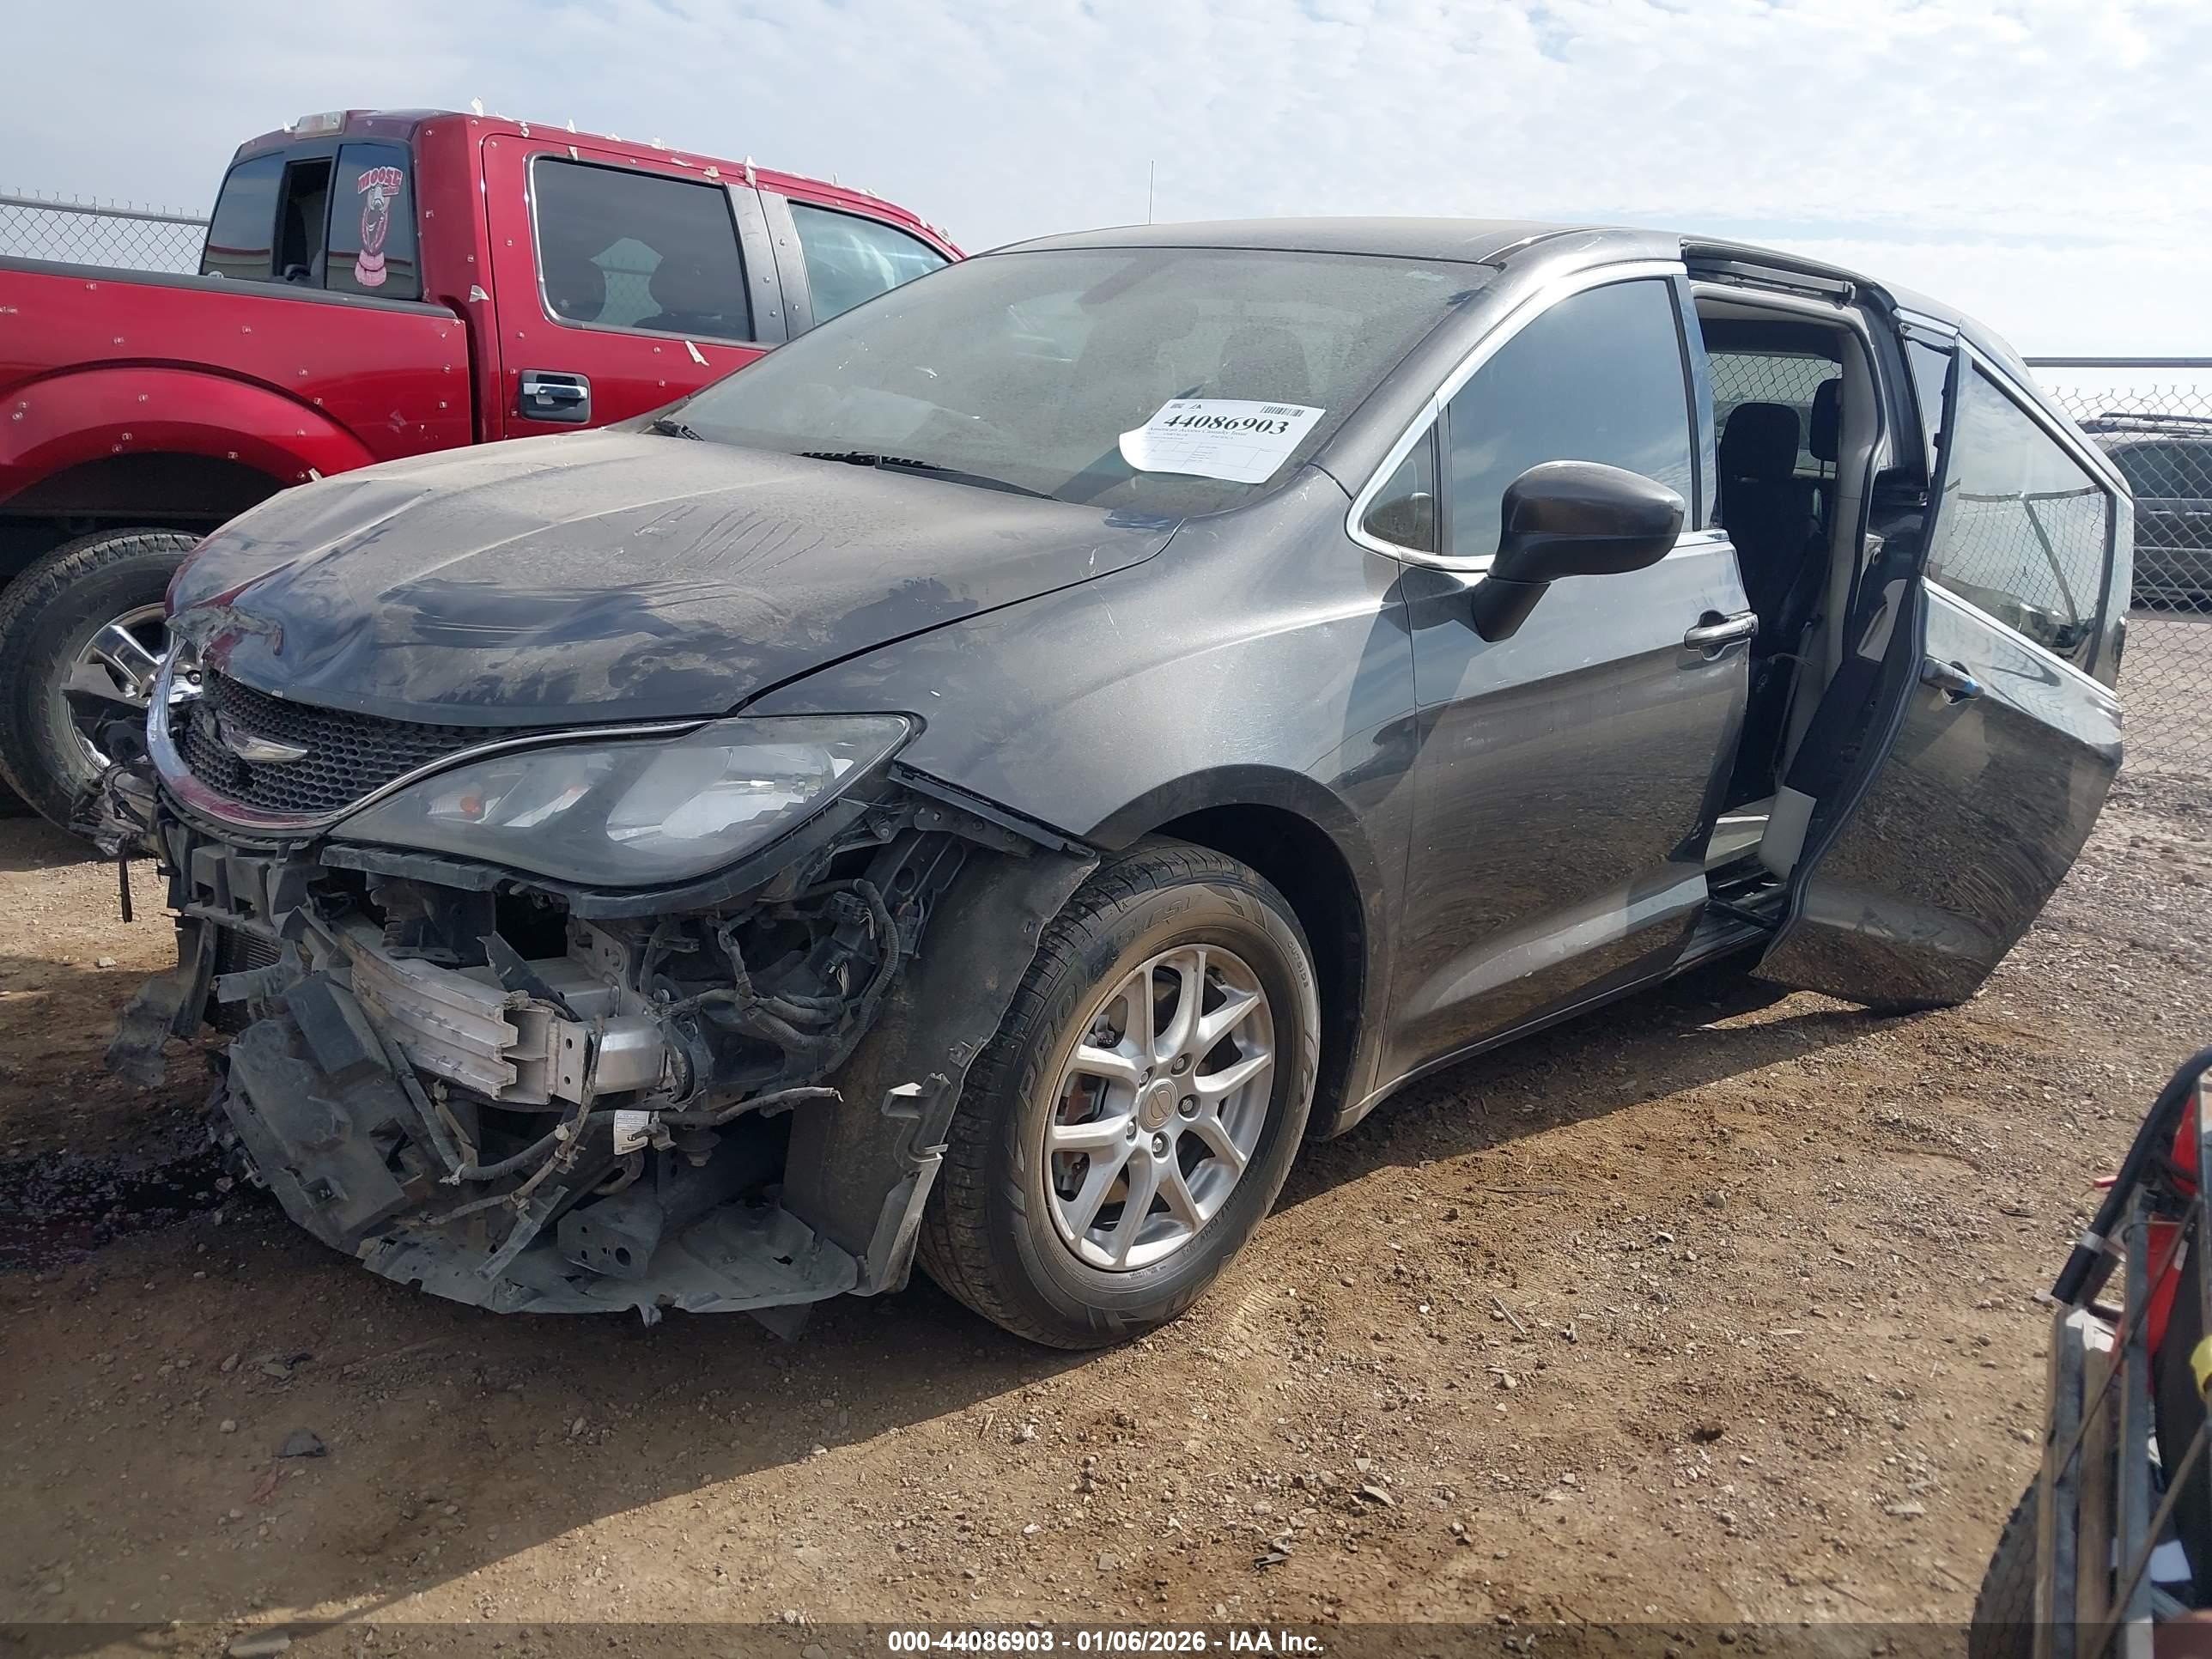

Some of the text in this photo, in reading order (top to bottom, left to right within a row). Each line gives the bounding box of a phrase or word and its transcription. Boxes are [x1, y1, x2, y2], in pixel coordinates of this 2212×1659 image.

[358, 167, 403, 194] MOOSE
[1164, 413, 1290, 436] 44086903
[1287, 940, 1310, 988] OUTSIDE
